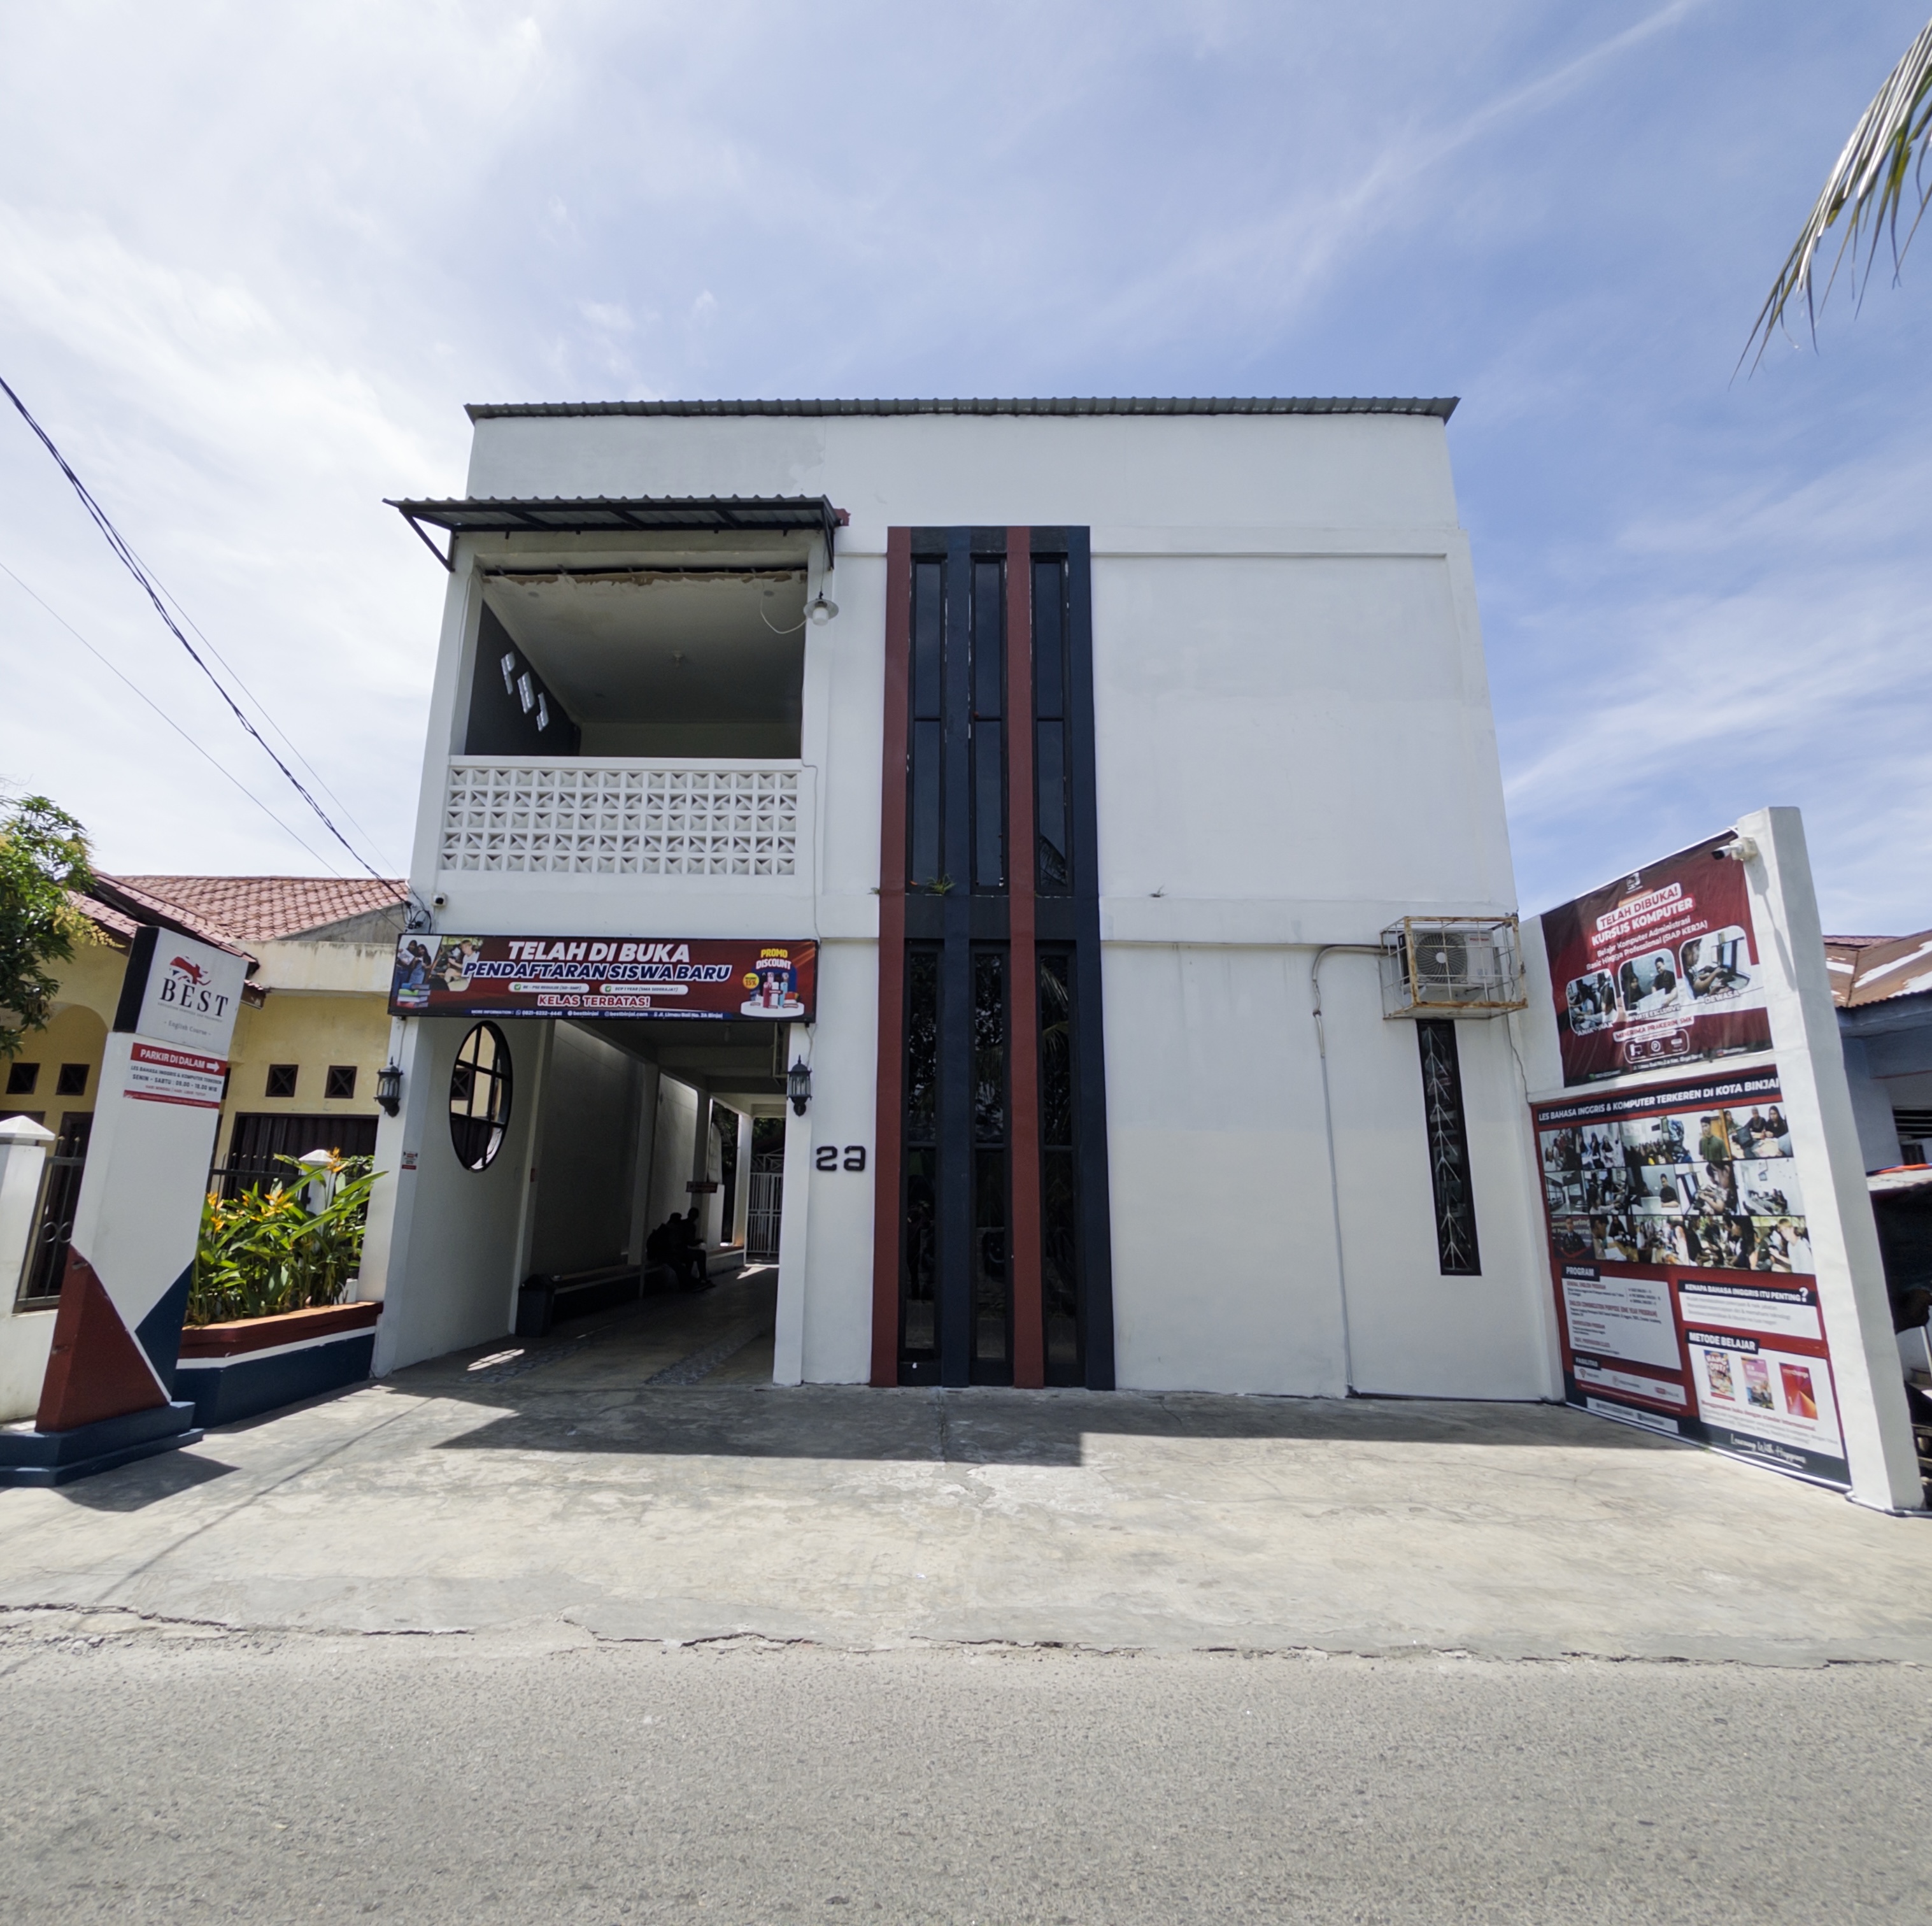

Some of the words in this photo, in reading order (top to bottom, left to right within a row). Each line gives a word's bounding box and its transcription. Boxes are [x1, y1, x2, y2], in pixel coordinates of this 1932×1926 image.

[1600, 907, 1632, 925] TELAH
[1634, 886, 1679, 913] DIBUKA!
[1592, 922, 1630, 946] KURSUS
[1631, 897, 1694, 930] KOMPUTER
[1617, 932, 1648, 949] Komputer
[1649, 915, 1691, 938] Administrasi
[508, 941, 588, 961] TELAH
[588, 942, 614, 962] DI
[618, 943, 690, 963] BUKA
[760, 948, 788, 958] PROMO
[461, 960, 609, 980] PENDAFTARAN
[609, 963, 676, 981] SISWA
[675, 964, 733, 982] BARU
[755, 958, 792, 970] DISCOUNT
[159, 978, 229, 1017] BEST
[537, 994, 581, 1007] KELAS
[582, 995, 651, 1008] TERBATAS!
[1704, 989, 1741, 1004] DEWASA
[1649, 1003, 1681, 1018] EXCLUSIVE
[168, 1020, 188, 1031] English
[189, 1025, 208, 1036] Course
[139, 1048, 169, 1061] PARKIR
[169, 1054, 178, 1064] DI
[178, 1055, 206, 1069] DALAM
[155, 1077, 172, 1085] SABTU
[1538, 1112, 1550, 1121] LES
[1550, 1108, 1577, 1120] BAHASA
[1577, 1104, 1605, 1115] INGGRIS
[1606, 1103, 1612, 1111] &
[1612, 1095, 1656, 1111] KOMPUTER
[1656, 1088, 1701, 1104] TERKEREN
[1703, 1088, 1714, 1097] DI
[1715, 1083, 1743, 1096] KOTA
[1744, 1077, 1780, 1091] BINJAI
[816, 1146, 866, 1171] 2a
[1565, 1266, 1595, 1276] PROGRAM
[1684, 1283, 1707, 1292] KENAPA
[1707, 1285, 1732, 1295] BAHASA
[1732, 1288, 1759, 1297] INGGRIS
[1759, 1290, 1770, 1299] ITU
[1689, 1332, 1721, 1346] METODE
[1721, 1335, 1756, 1351] BELAJAR
